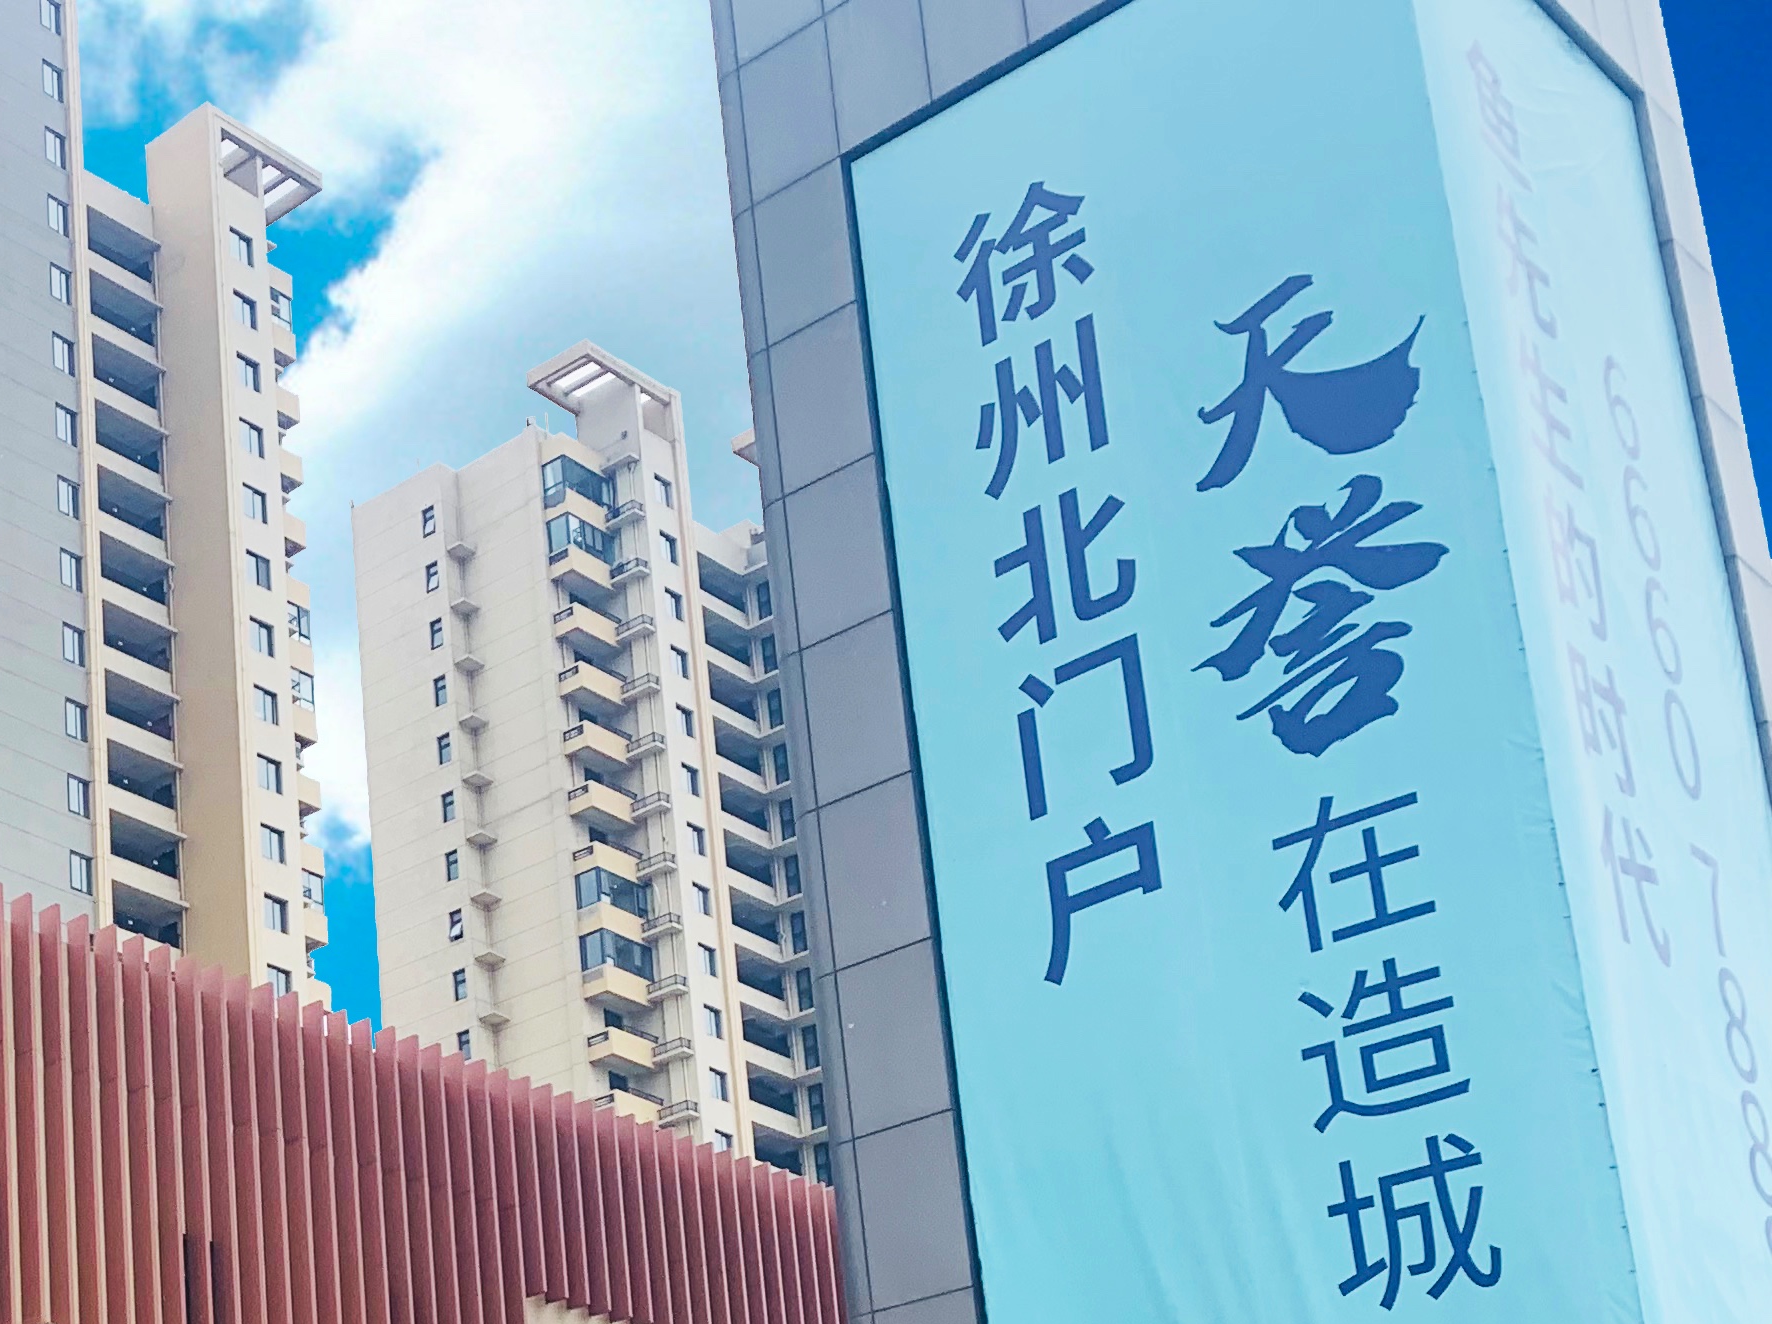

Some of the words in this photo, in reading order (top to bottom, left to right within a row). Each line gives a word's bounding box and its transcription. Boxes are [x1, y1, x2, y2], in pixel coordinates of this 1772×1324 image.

[953, 181, 1163, 986] 徐州北门户
